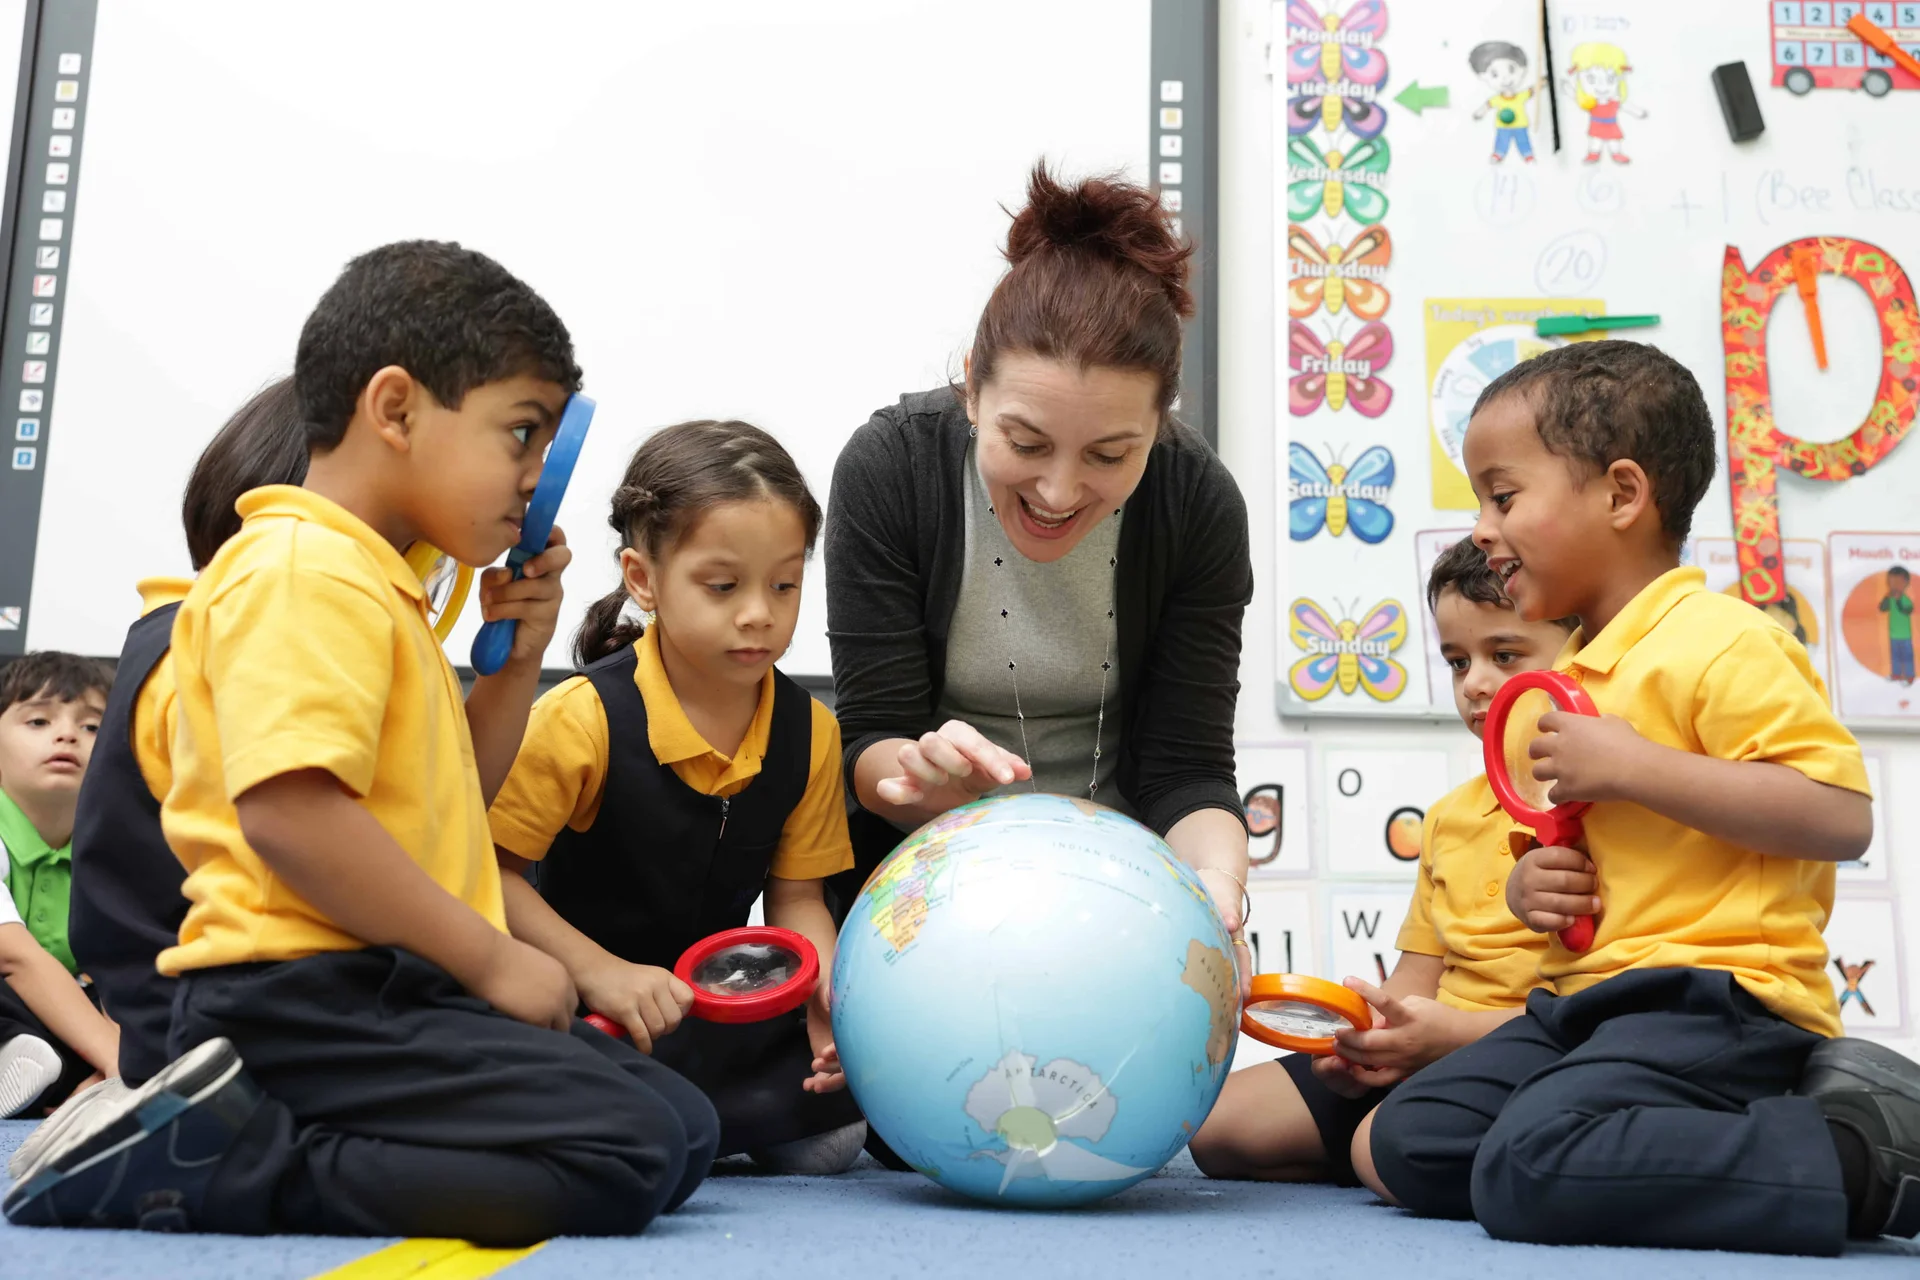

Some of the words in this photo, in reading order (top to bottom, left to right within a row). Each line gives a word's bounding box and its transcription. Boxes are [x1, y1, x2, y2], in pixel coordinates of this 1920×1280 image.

[1784, 7, 1791, 21] 1
[1811, 7, 1822, 22] 2
[1841, 7, 1852, 23] 3
[1873, 8, 1884, 23] 4
[1904, 7, 1915, 23] 5
[1290, 27, 1374, 49] Monday
[1784, 46, 1795, 61] 6
[1813, 47, 1824, 62] 7
[1844, 47, 1855, 63] 8
[1301, 355, 1372, 379] Friday
[1288, 478, 1388, 507] Saturday
[1307, 635, 1390, 661] Sunday
[1053, 841, 1101, 856] INDIAN
